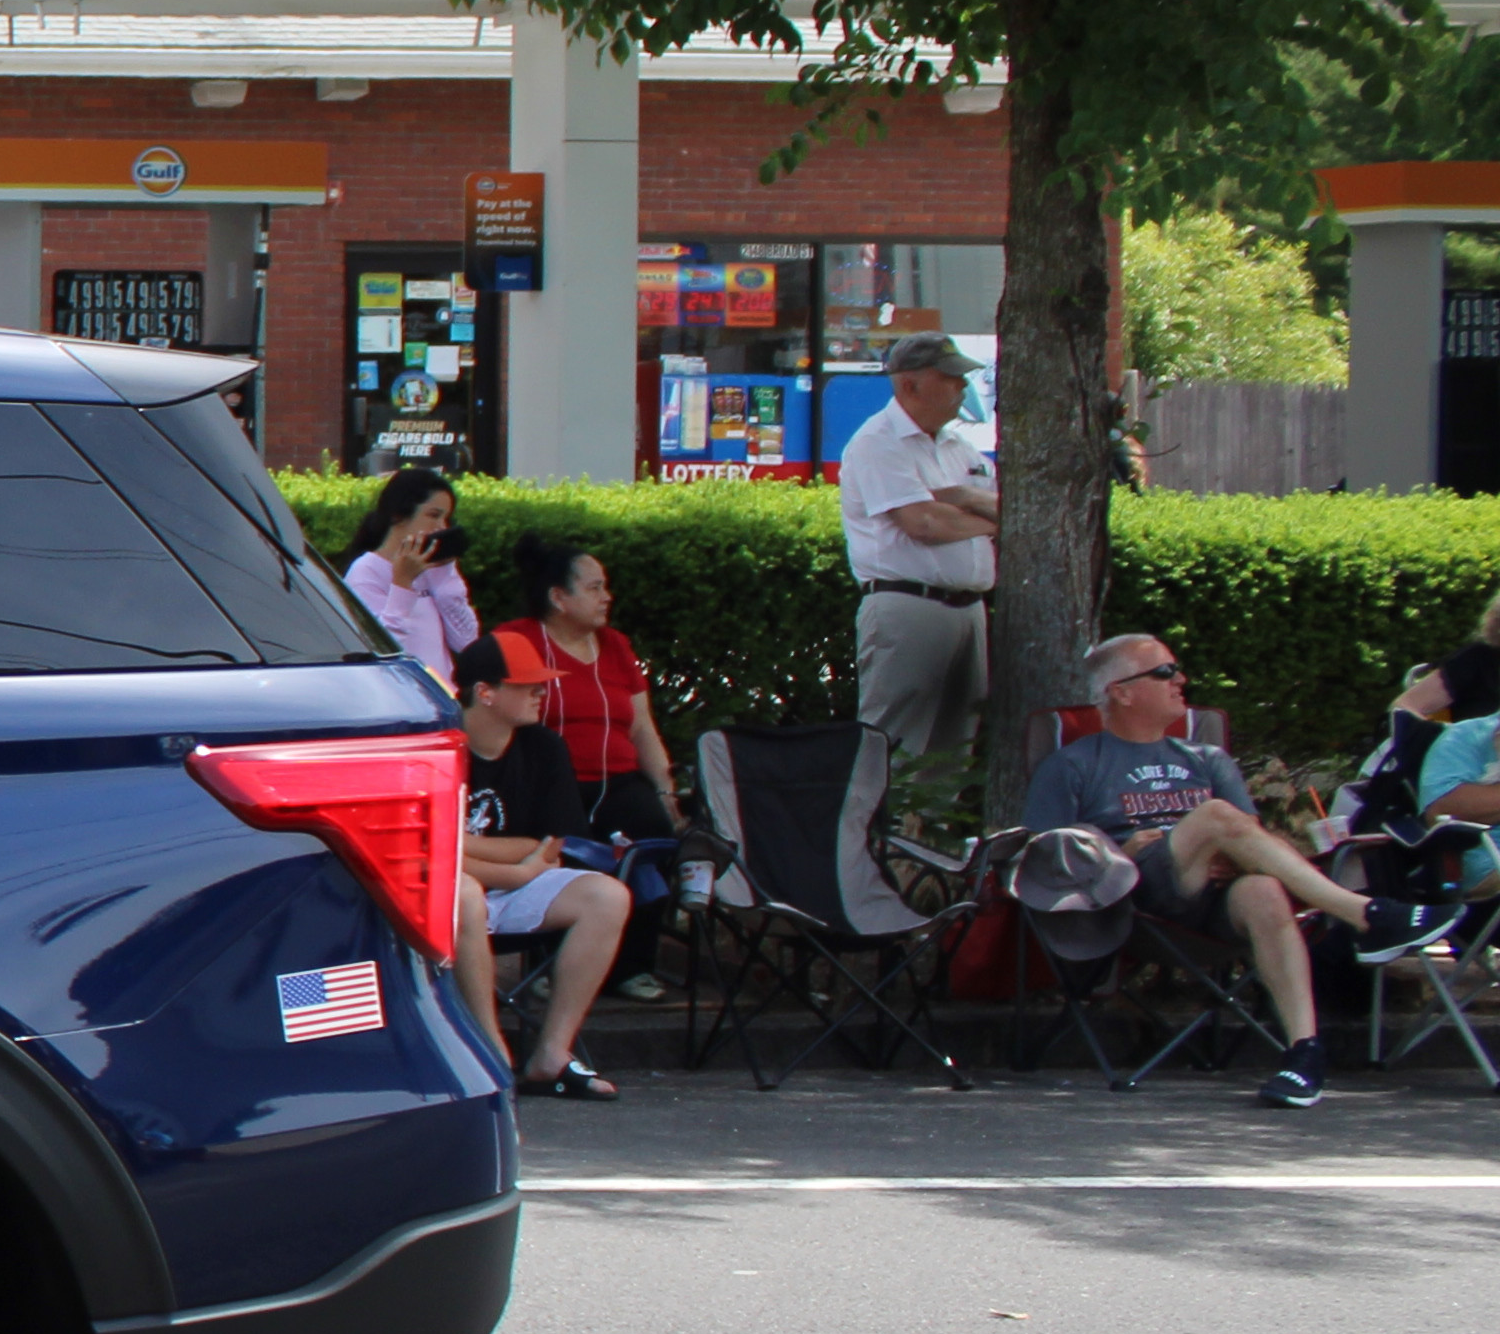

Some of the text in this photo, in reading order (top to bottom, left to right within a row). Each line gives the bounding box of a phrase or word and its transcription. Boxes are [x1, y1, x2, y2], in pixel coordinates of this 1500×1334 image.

[136, 164, 182, 180] Gulf
[476, 199, 532, 210] Pay at the
[476, 211, 527, 223] speed of
[476, 224, 505, 235] right
[389, 421, 445, 432] PREMIUM
[378, 432, 455, 445] CIGARS SOLD
[399, 445, 433, 457] HERE
[661, 463, 756, 483] LOTTERY
